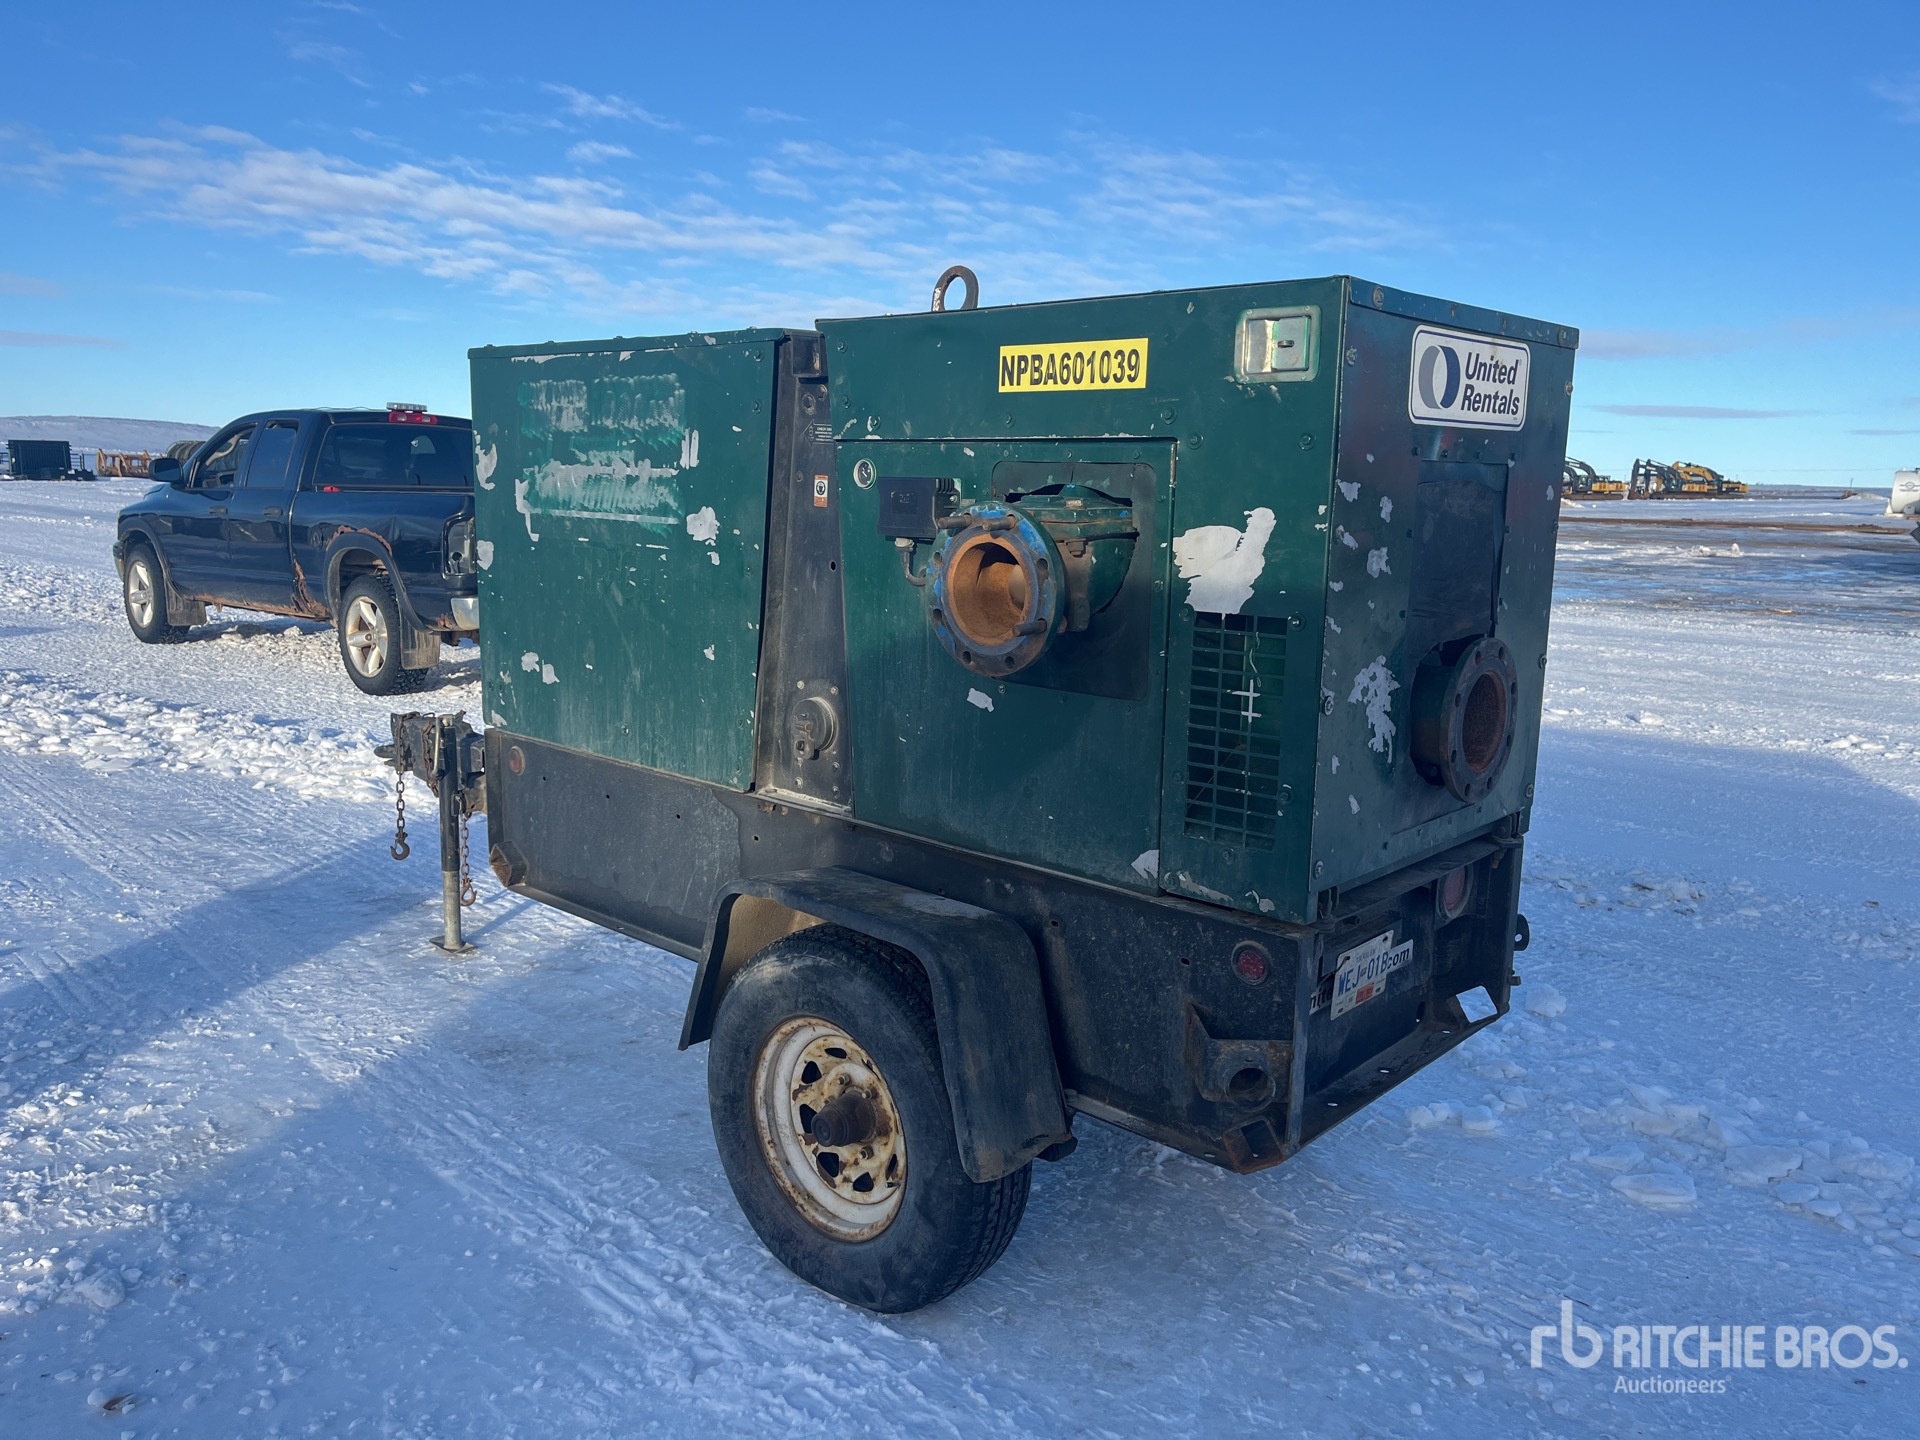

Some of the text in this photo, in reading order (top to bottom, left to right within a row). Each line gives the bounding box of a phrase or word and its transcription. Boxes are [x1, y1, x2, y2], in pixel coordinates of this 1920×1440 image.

[1001, 348, 1141, 387] NPBA601039
[1465, 351, 1519, 385] United
[1460, 383, 1520, 416] Rentals
